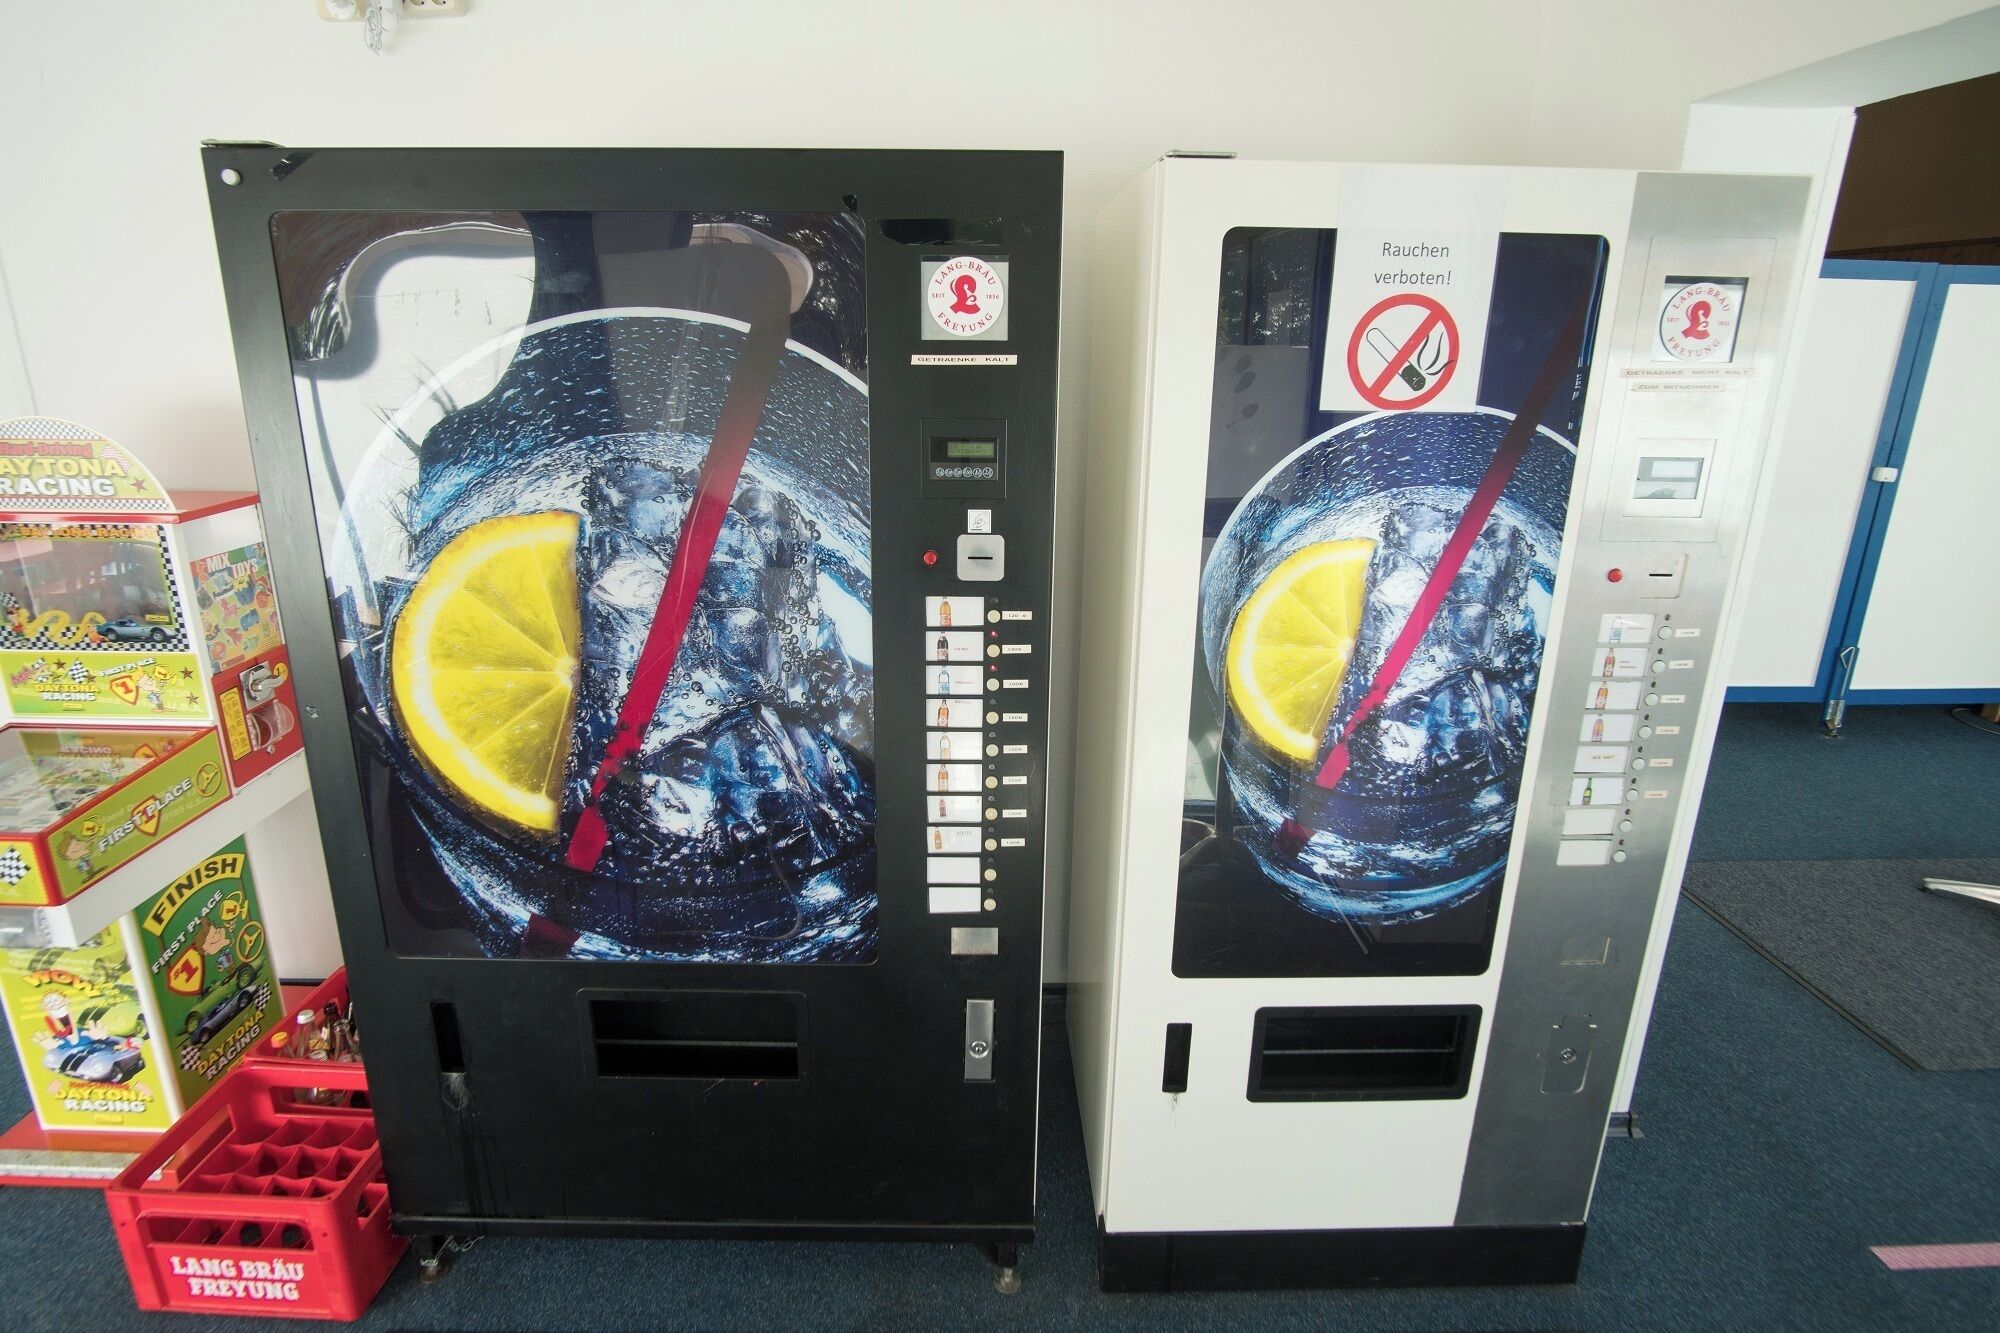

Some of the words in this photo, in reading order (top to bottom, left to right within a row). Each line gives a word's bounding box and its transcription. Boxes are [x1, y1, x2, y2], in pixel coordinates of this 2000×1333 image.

[1382, 242, 1449, 258] Rauchen
[935, 261, 996, 286] LANG-BRÄU
[1374, 269, 1451, 285] verboten!
[937, 311, 993, 332] FREYUNG
[1667, 336, 1720, 357] FREYUNG
[206, 552, 231, 573] MIX
[232, 558, 258, 577] TOYS
[99, 663, 128, 677] FIRST
[35, 683, 100, 693] DAYTONA
[41, 692, 96, 701] RACING
[98, 812, 142, 853] FIRST
[145, 777, 193, 818] PLACE
[151, 857, 238, 926] FINISH
[151, 931, 186, 975] FIRST
[187, 889, 224, 933] PLACE
[197, 1010, 264, 1077] DAYTONA
[206, 1023, 262, 1081] RACING
[54, 1088, 154, 1101] DAYTONA
[64, 1099, 147, 1113] RACING
[170, 1255, 237, 1278] LANG
[239, 1257, 305, 1281] BRÄU
[187, 1276, 300, 1301] FREYUNG
